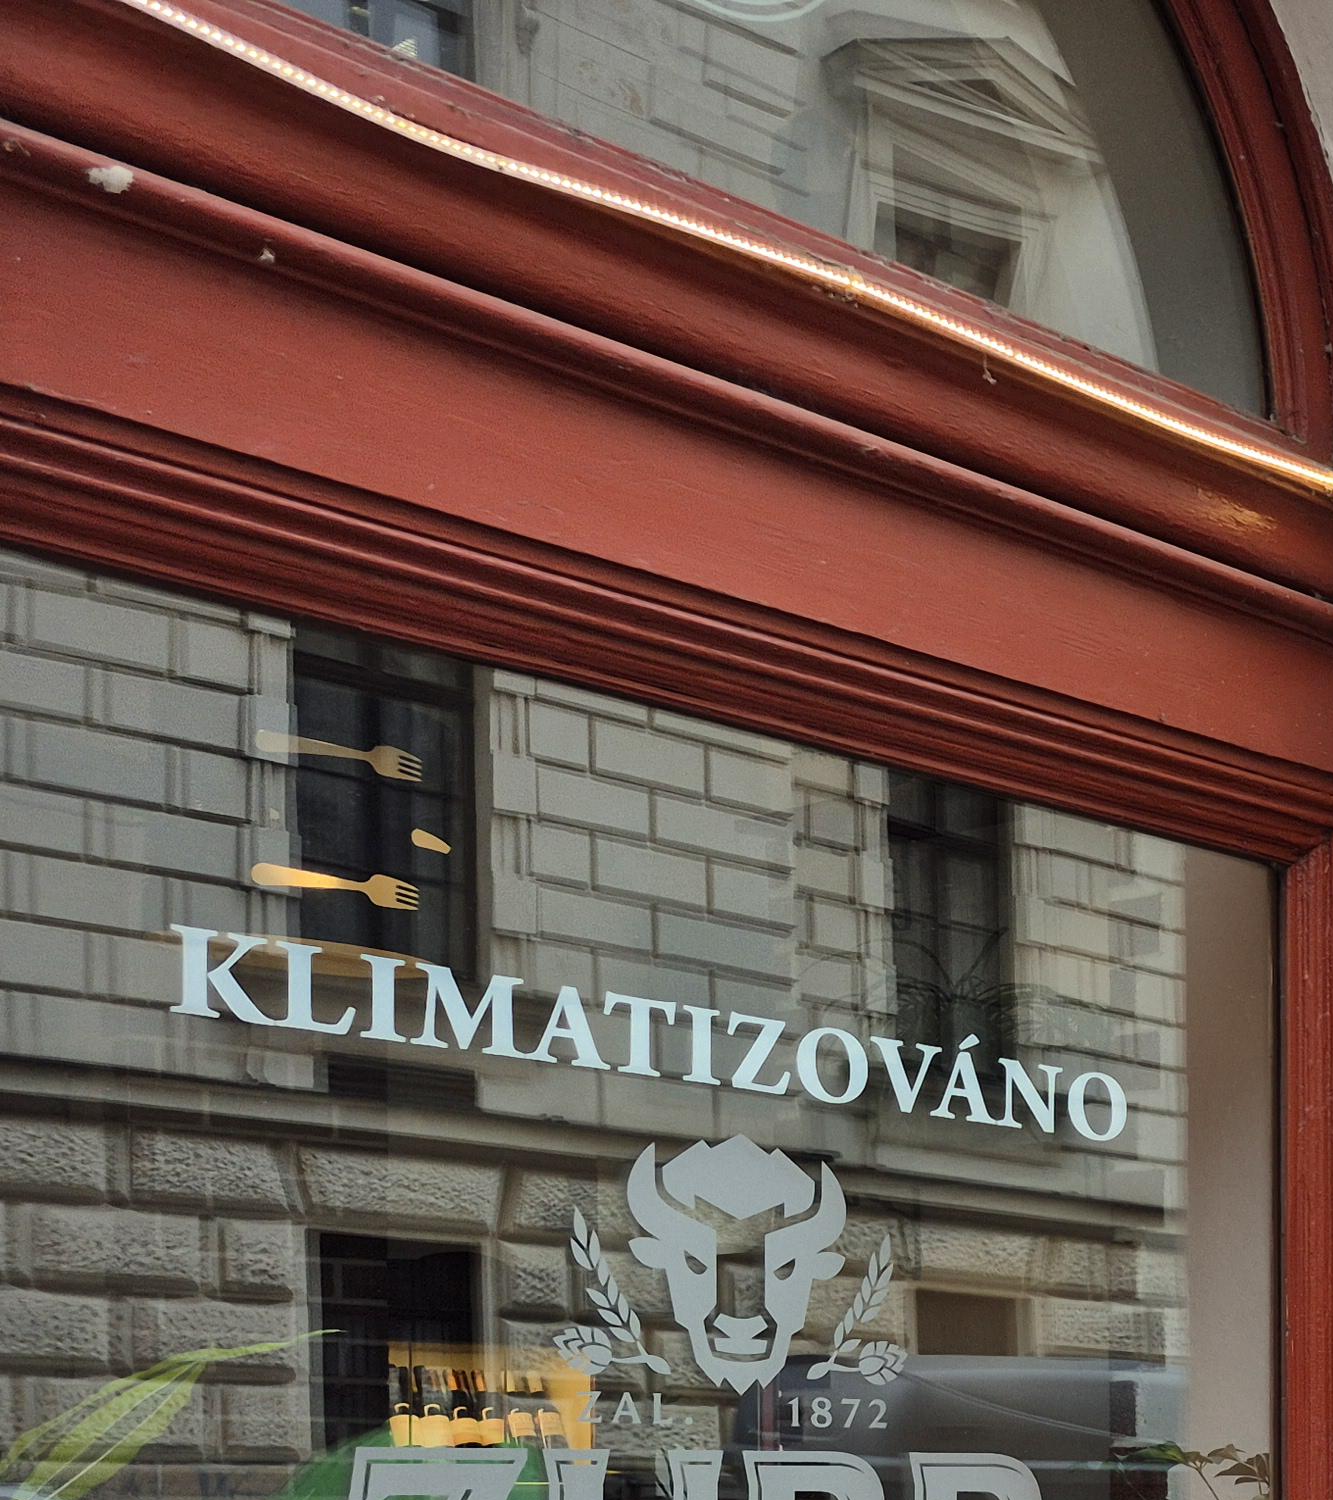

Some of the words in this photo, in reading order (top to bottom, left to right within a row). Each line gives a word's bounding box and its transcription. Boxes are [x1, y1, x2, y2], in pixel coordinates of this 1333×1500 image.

[169, 923, 1128, 1141] KLIMATIZOVÁNO
[576, 1391, 694, 1425] ZAL.
[787, 1397, 888, 1428] 1872
